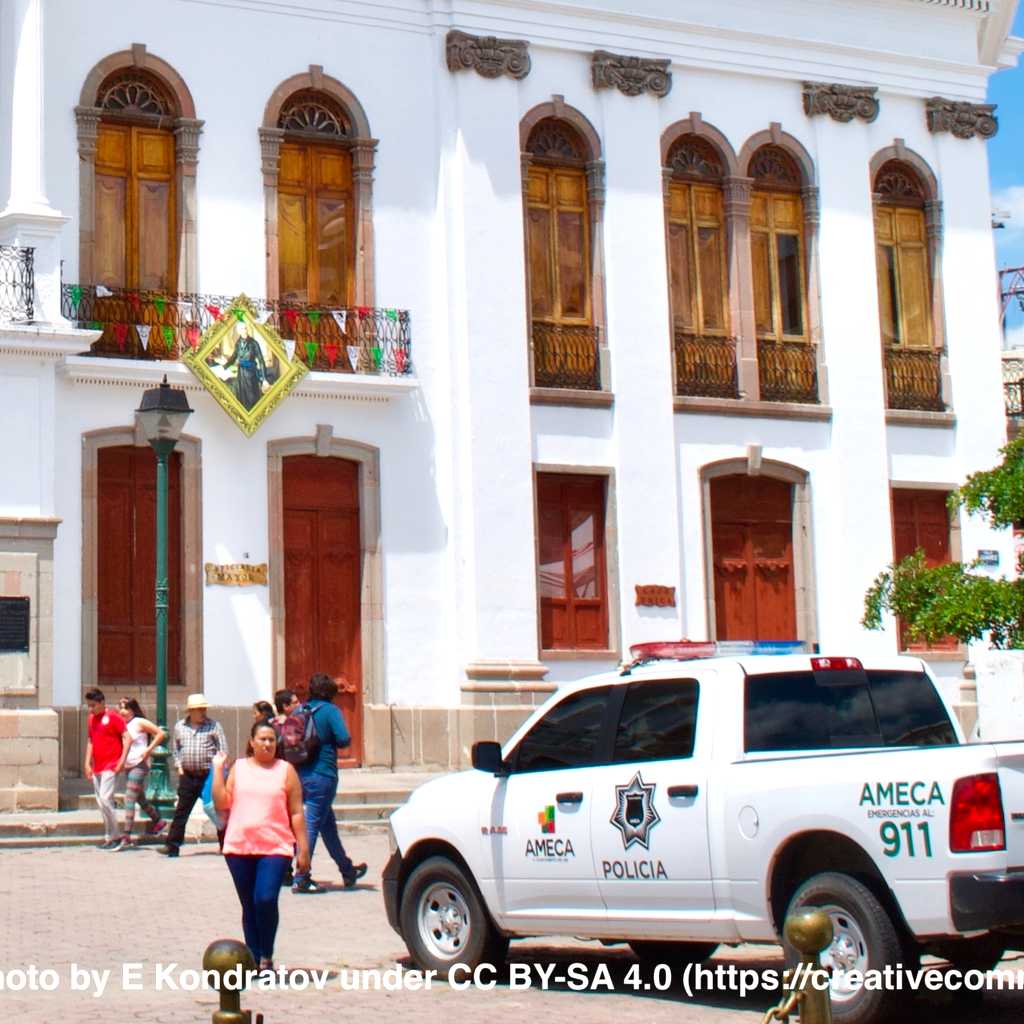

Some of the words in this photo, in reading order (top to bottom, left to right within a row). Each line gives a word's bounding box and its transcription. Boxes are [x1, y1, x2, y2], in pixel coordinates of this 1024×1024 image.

[859, 781, 945, 806] AMECA
[867, 809, 920, 819] EMERGENCIAS
[525, 839, 576, 857] AMECA
[879, 820, 933, 858] 911
[602, 860, 669, 880] POLICIA
